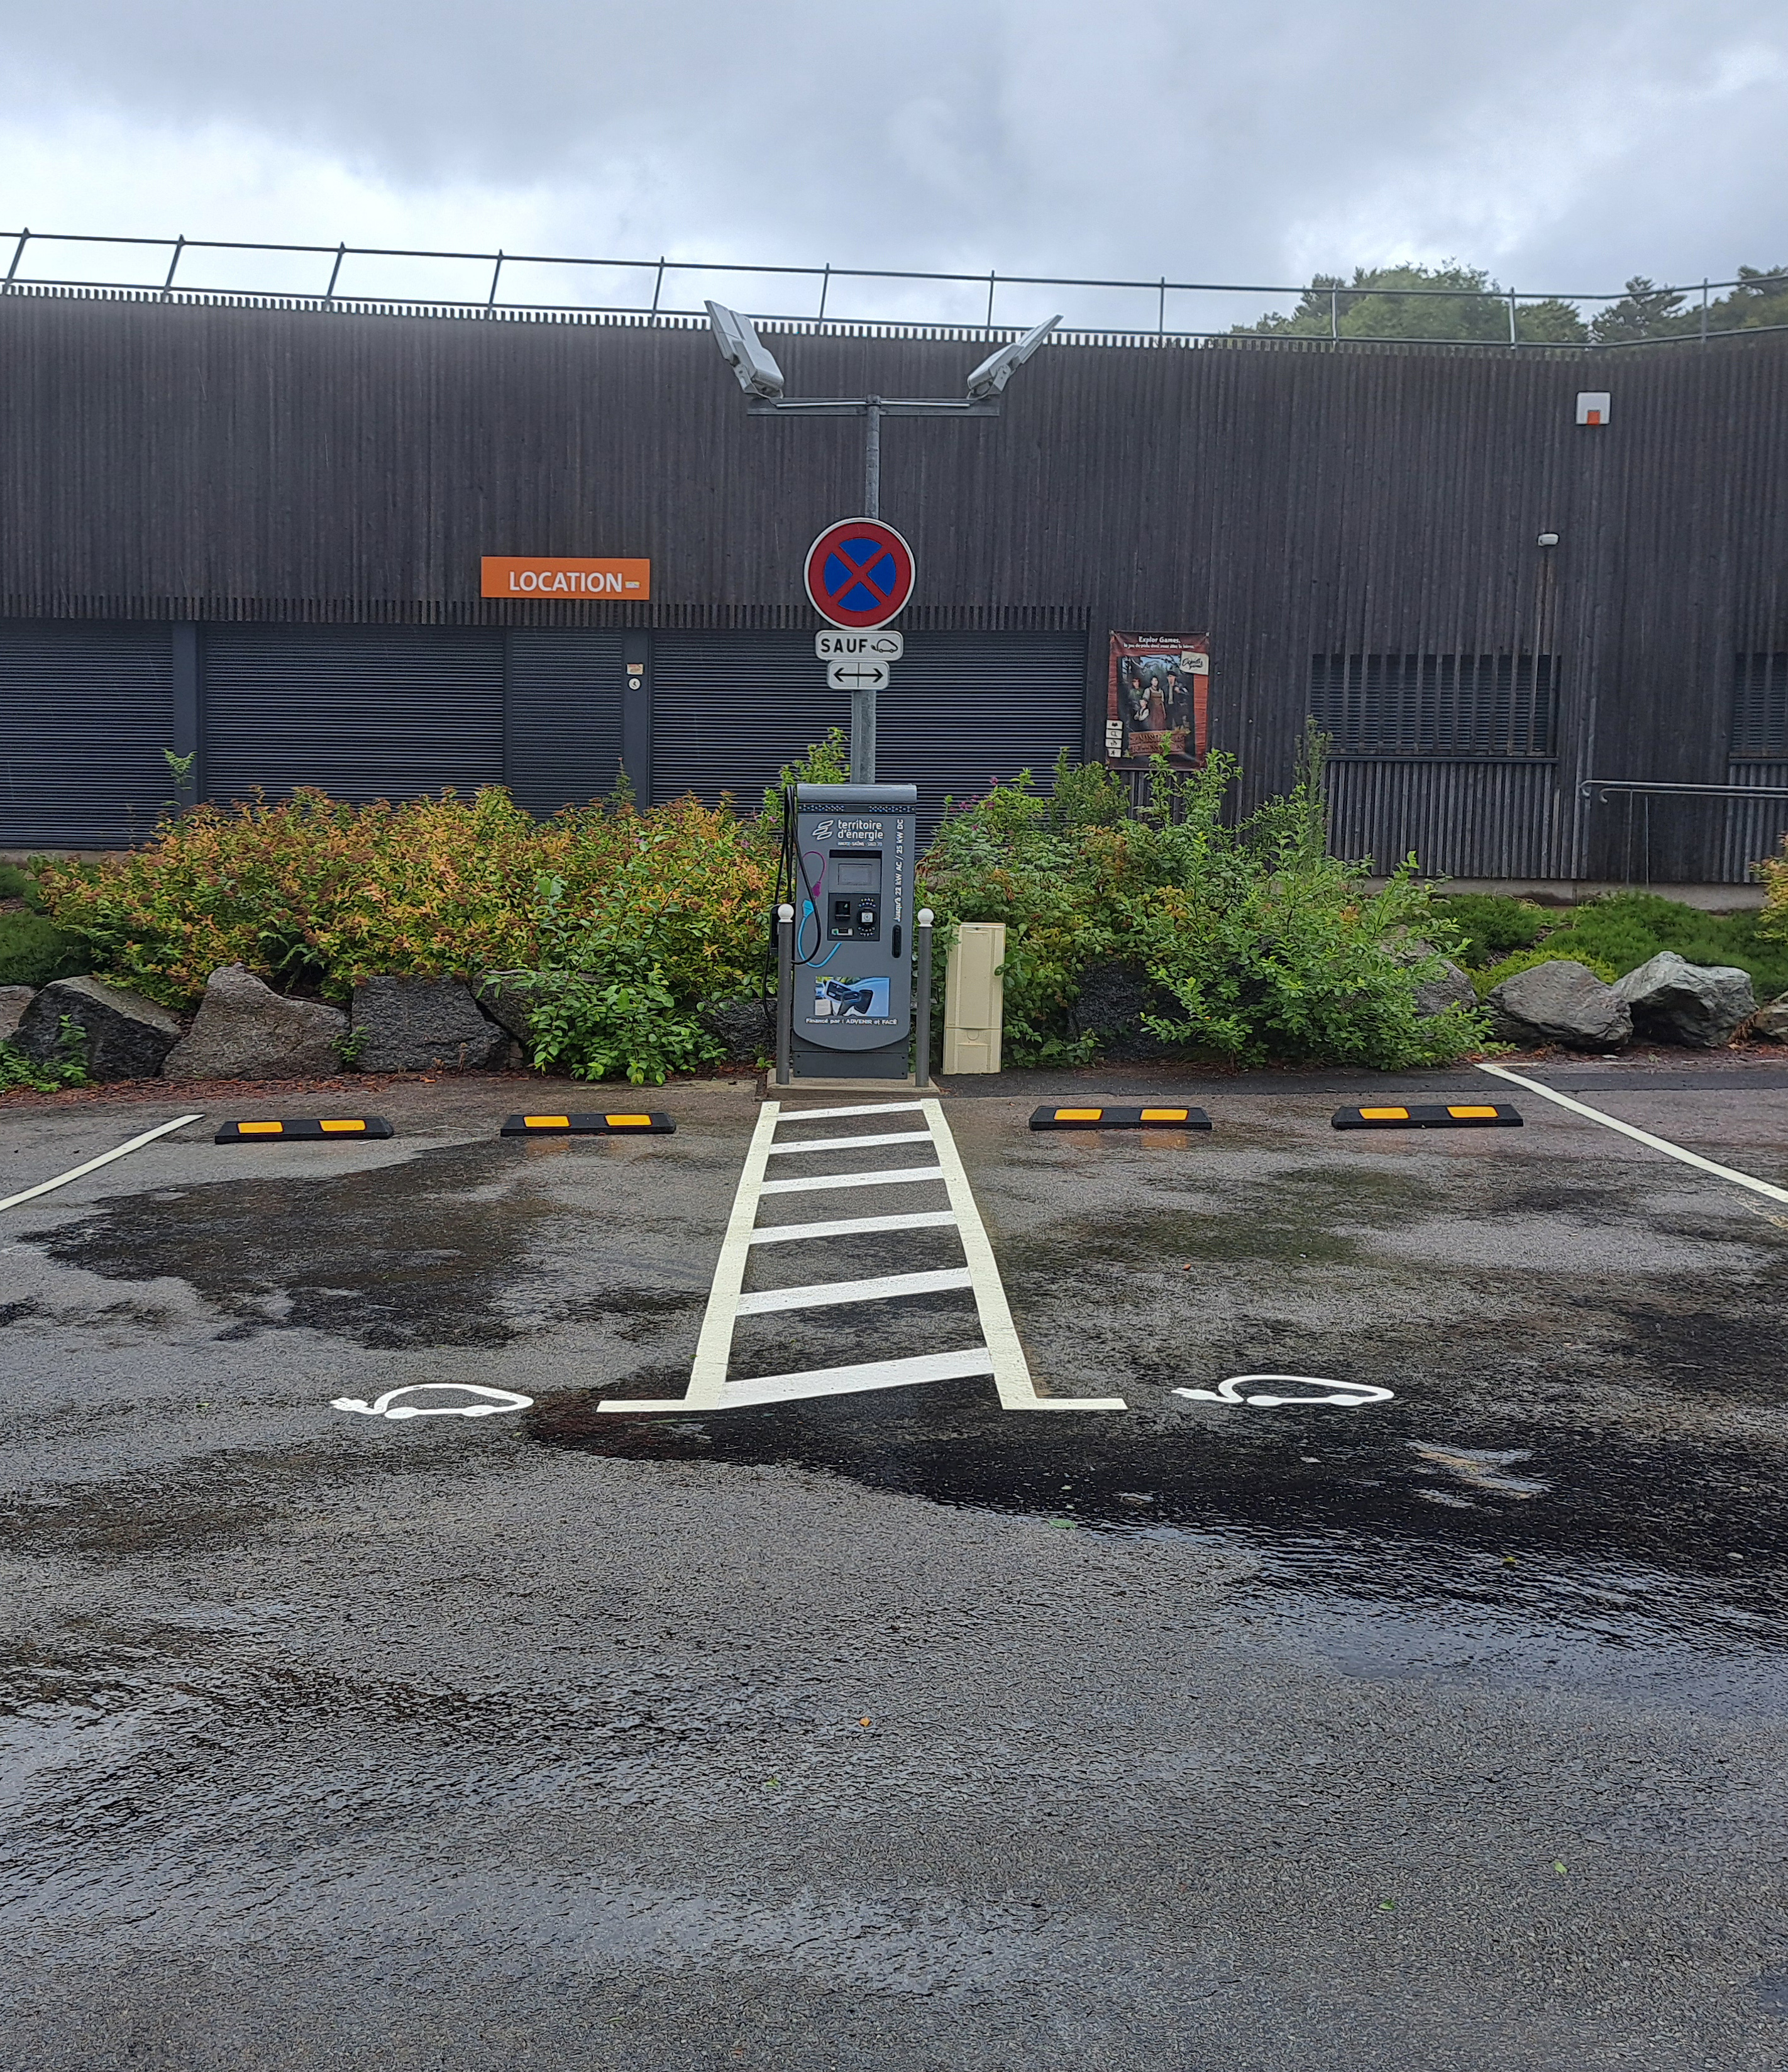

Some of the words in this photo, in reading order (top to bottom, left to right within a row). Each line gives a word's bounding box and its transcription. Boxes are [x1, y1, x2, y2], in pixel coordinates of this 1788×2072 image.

[509, 571, 622, 592] LOCATION
[820, 638, 868, 653] SAUF
[837, 818, 883, 830] territoire
[897, 818, 903, 830] DC
[895, 831, 904, 844] kW
[896, 845, 903, 854] 25
[895, 861, 902, 872] AC
